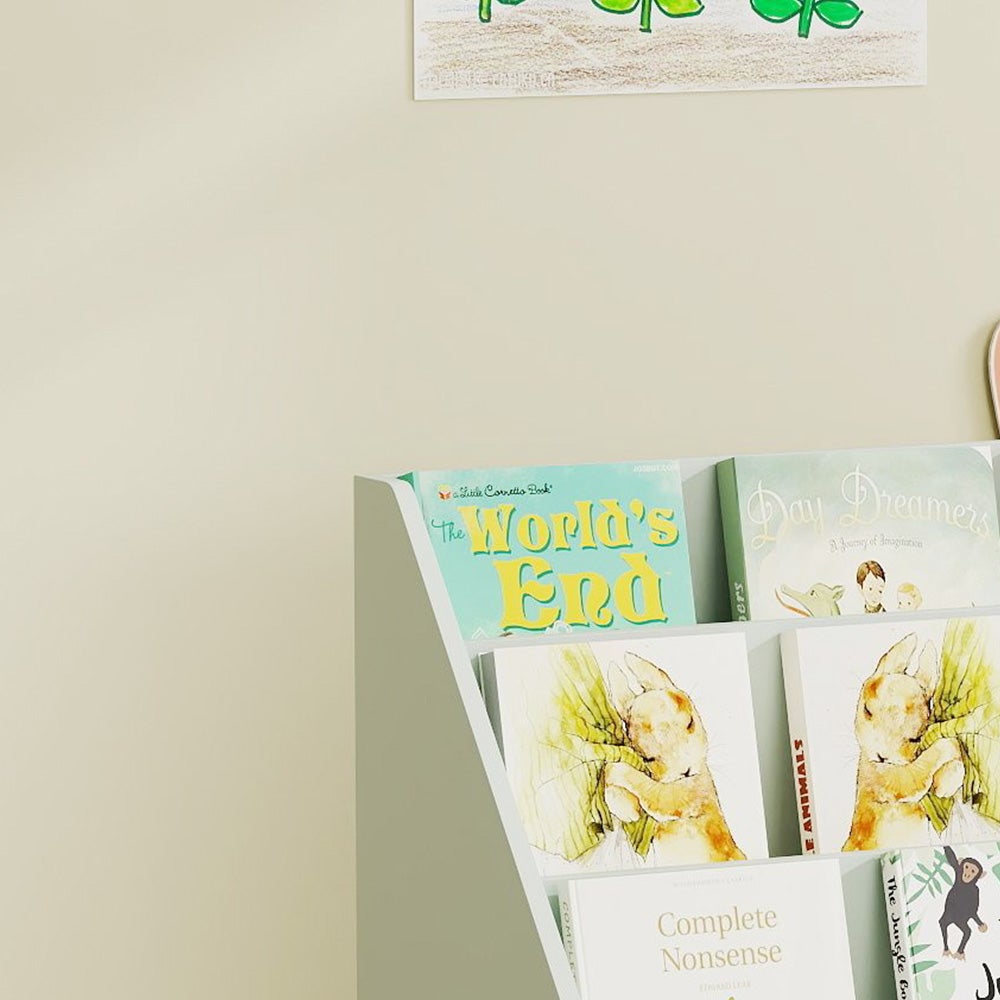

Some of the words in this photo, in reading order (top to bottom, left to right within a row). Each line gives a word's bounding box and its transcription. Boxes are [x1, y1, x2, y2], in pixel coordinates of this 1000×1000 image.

[528, 483, 550, 495] Book
[747, 480, 824, 549] Day
[840, 464, 991, 540] Dreamers
[431, 519, 465, 543] The
[458, 498, 680, 555] World's
[869, 534, 878, 546] of
[493, 553, 669, 631] End
[794, 739, 813, 832] ANIMALS
[887, 875, 896, 907] The
[657, 905, 777, 940] Complete
[891, 912, 905, 973] Jungle
[660, 943, 783, 973] Nonsense
